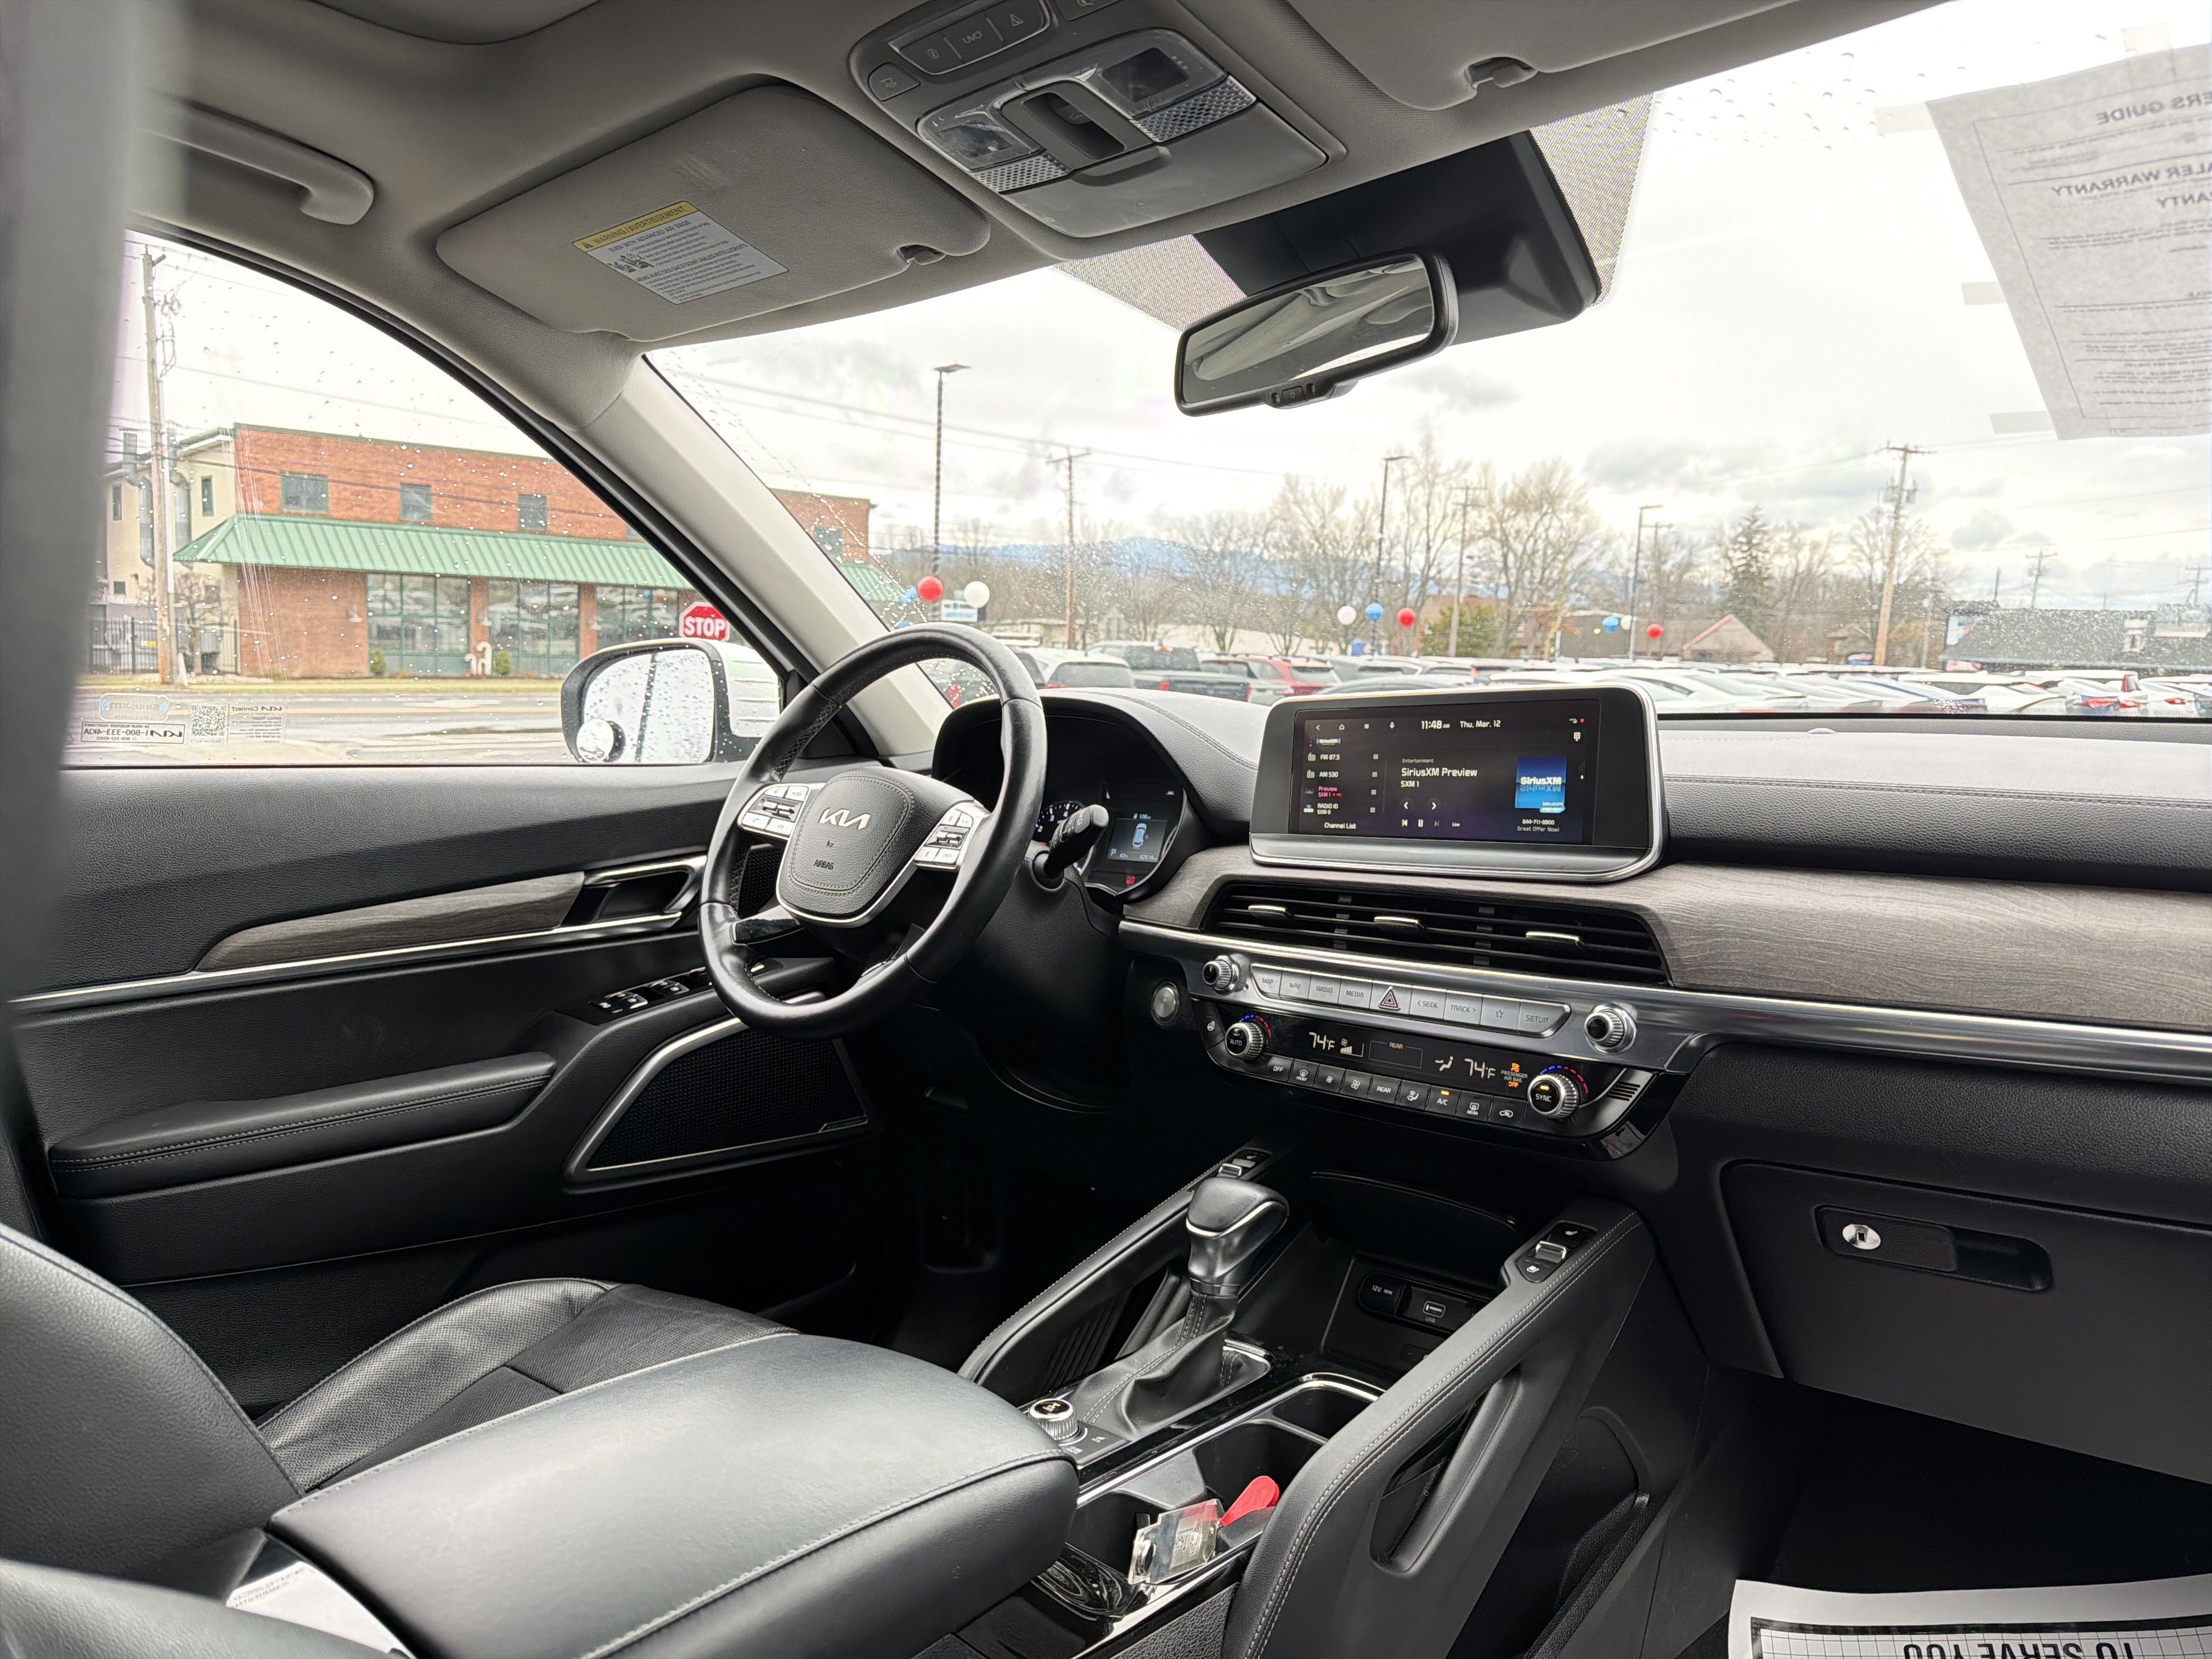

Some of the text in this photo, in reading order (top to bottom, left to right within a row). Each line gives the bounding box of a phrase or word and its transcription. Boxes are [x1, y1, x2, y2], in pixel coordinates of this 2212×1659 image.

[963, 31, 982, 43] UVO
[592, 229, 626, 244] WARNING
[684, 616, 726, 639] STOP
[1421, 720, 1442, 729] 11:48
[1401, 768, 1478, 776] SiriusXM Preview
[1520, 776, 1562, 785] SiriusXM
[819, 807, 871, 830] KIA
[1451, 1005, 1470, 1013] TRACK
[1526, 1015, 1548, 1024] SETUP
[1501, 1070, 1527, 1079] PASSENGER
[1536, 1093, 1552, 1103] SYNC
[1372, 1284, 1382, 1293] 12V
